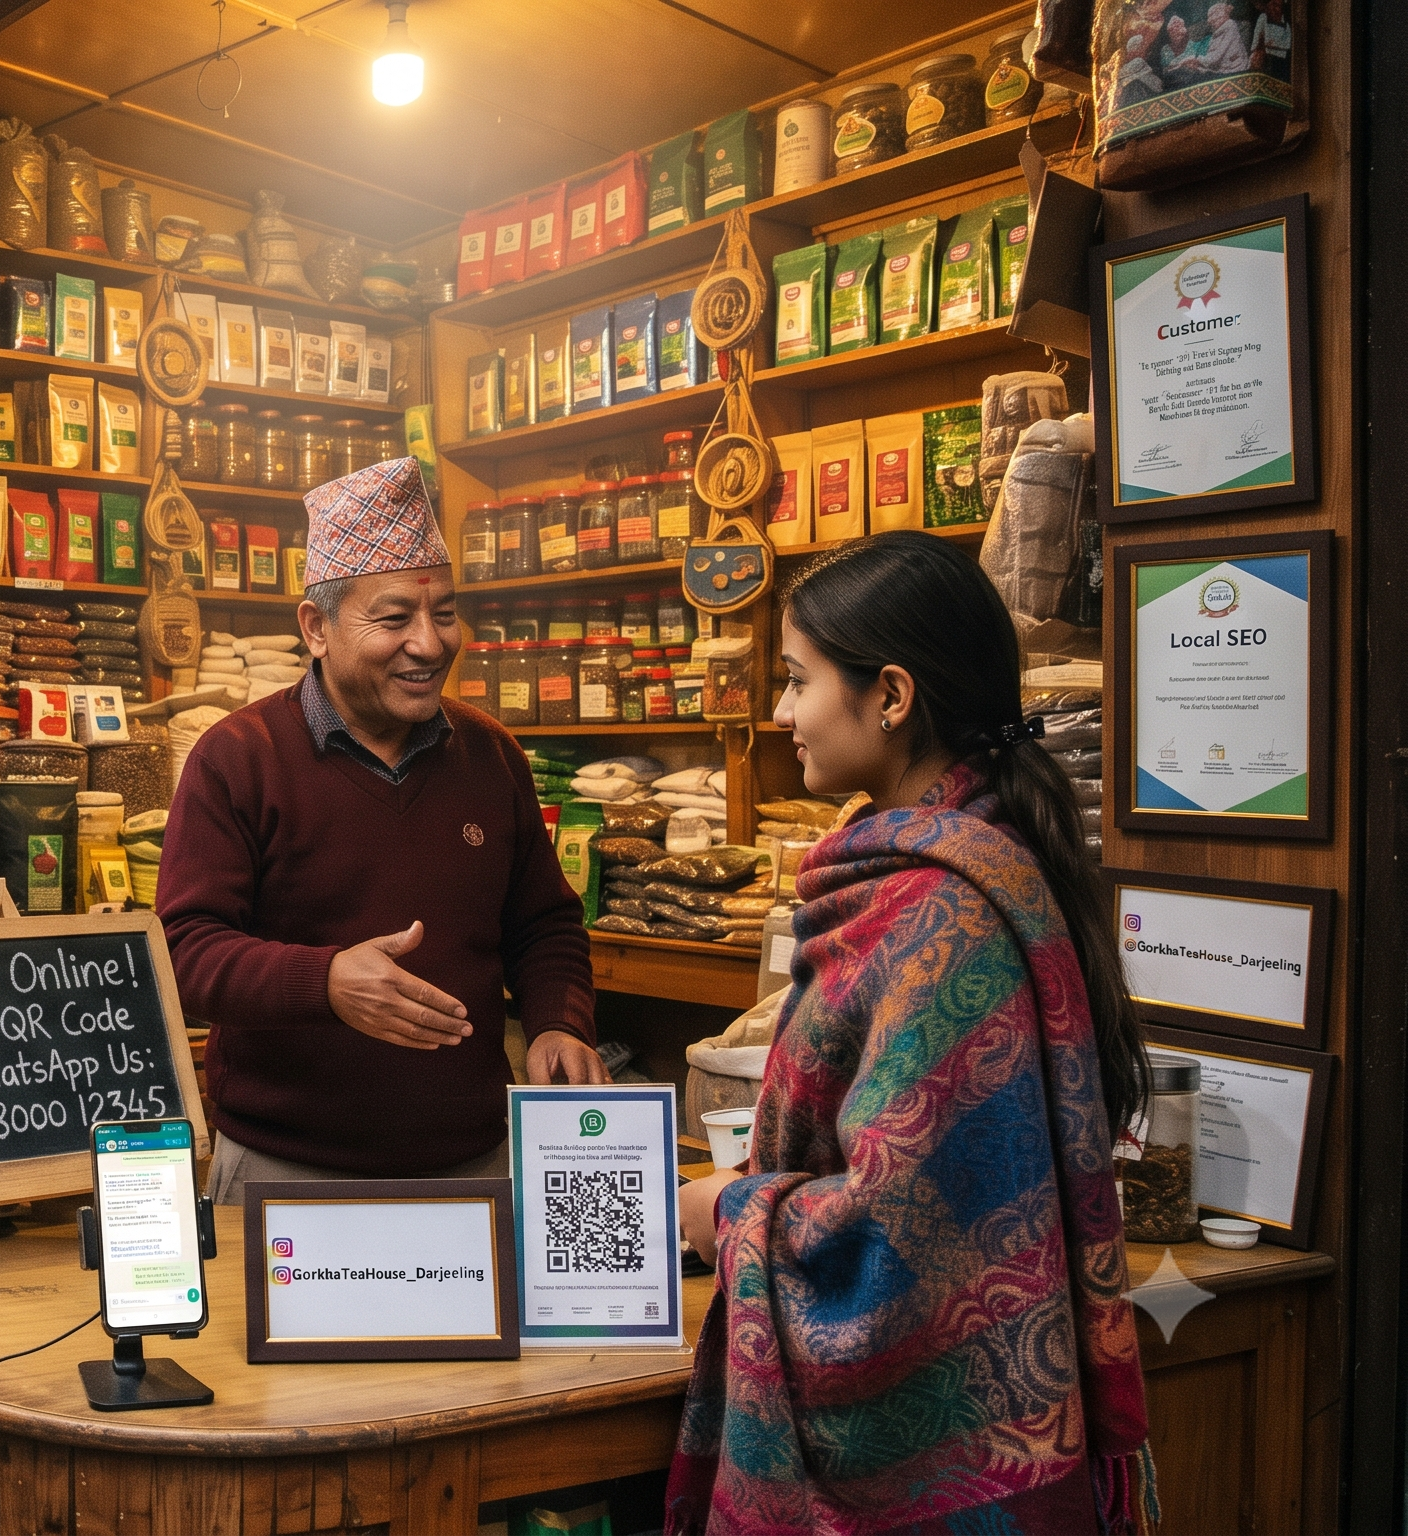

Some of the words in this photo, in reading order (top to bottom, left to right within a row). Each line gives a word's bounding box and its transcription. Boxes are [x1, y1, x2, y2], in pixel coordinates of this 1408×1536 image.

[1170, 630, 1220, 648] Local
[1227, 628, 1267, 646] SEO
[10, 943, 138, 993] Online!
[0, 1003, 52, 1042] QR
[61, 998, 135, 1036] Code
[107, 1043, 155, 1075] Us:
[78, 1085, 167, 1127] 12345
[292, 1267, 484, 1282] GorkhaTeaHouse_Darjeeling
